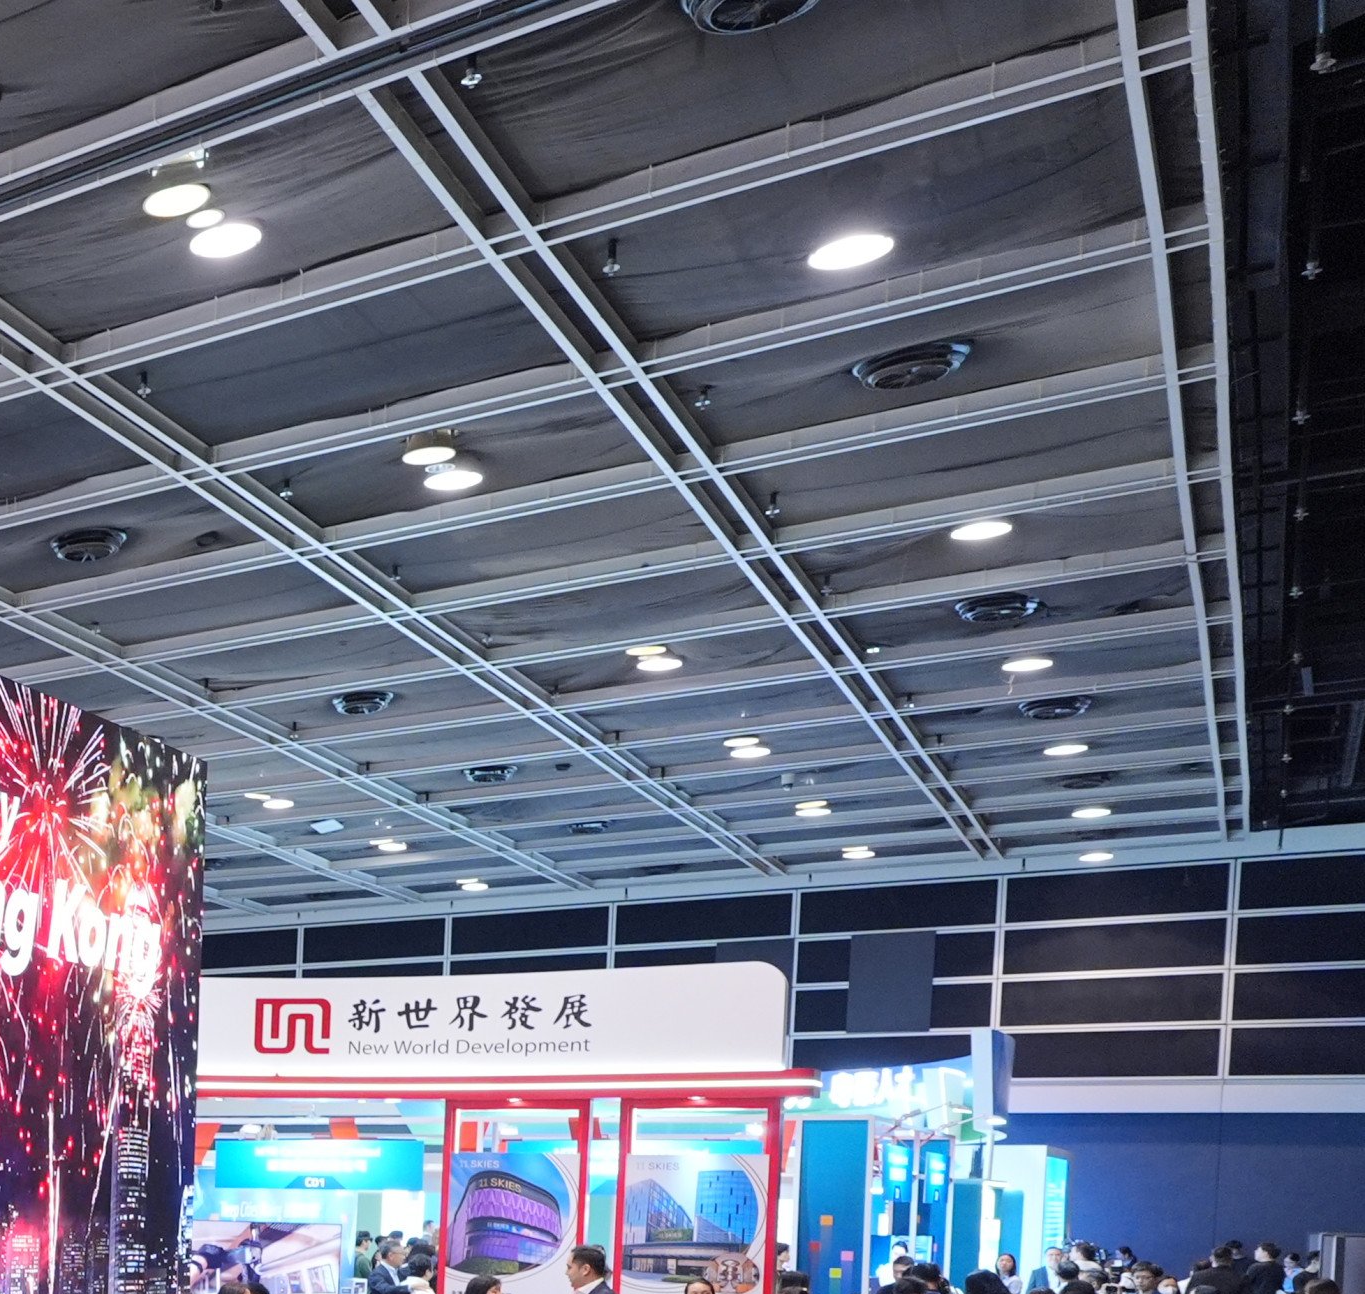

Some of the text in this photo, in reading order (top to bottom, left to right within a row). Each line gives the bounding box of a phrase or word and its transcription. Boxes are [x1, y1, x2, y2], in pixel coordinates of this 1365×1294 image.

[46, 877, 161, 999] Kong
[348, 994, 593, 1034] 新世界發展
[348, 1037, 591, 1058] New World Development
[470, 1160, 500, 1168] SKIES
[648, 1162, 680, 1171] SKIES
[490, 1178, 522, 1193] SKIES
